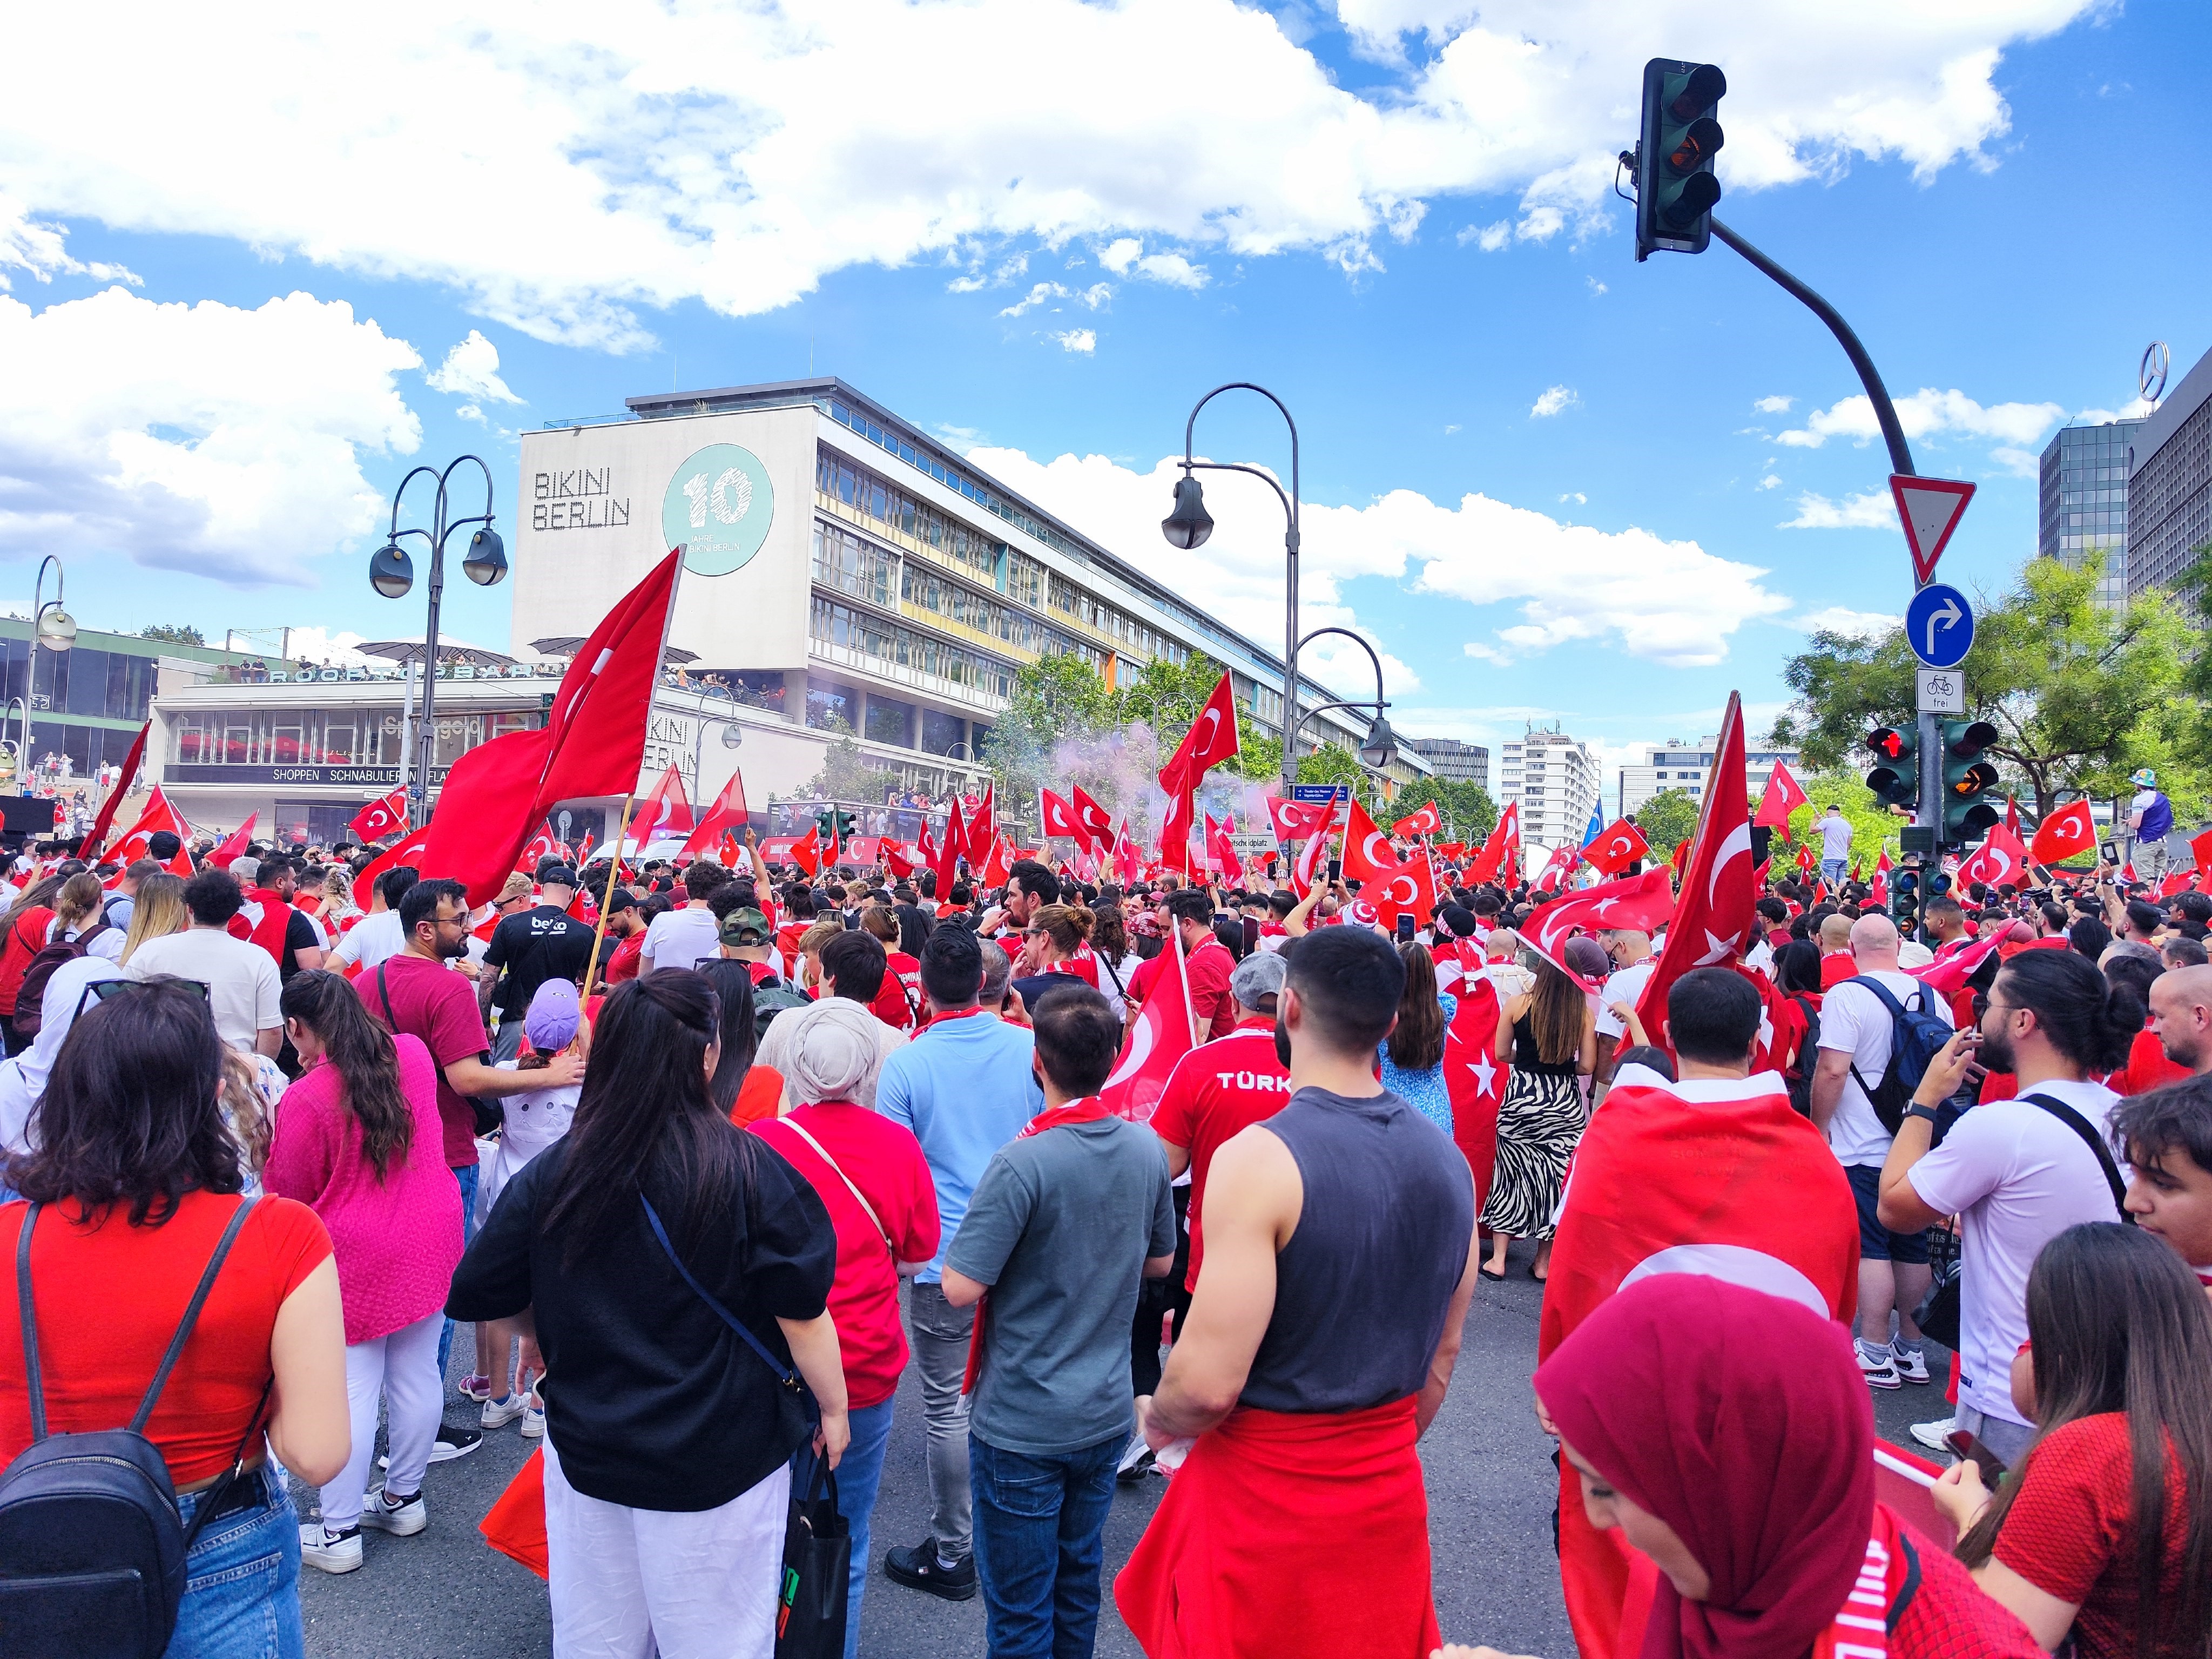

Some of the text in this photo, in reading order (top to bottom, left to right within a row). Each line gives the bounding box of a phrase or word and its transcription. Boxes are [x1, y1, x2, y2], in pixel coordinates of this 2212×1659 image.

[535, 467, 610, 500] BIKINI
[683, 467, 753, 528] 10
[533, 498, 630, 531] BERLIN
[690, 534, 714, 543] JAHRE
[689, 543, 740, 553] BIKINI BERLIN
[1934, 698, 1948, 707] frei
[650, 715, 687, 744] KINI
[273, 768, 449, 782] SHOPPEN SCHNABULIERN FLA
[1231, 839, 1267, 848] itscheidplatz
[531, 916, 567, 930] beko
[1072, 948, 1091, 961] LAND
[1216, 1070, 1292, 1093] TÜRK
